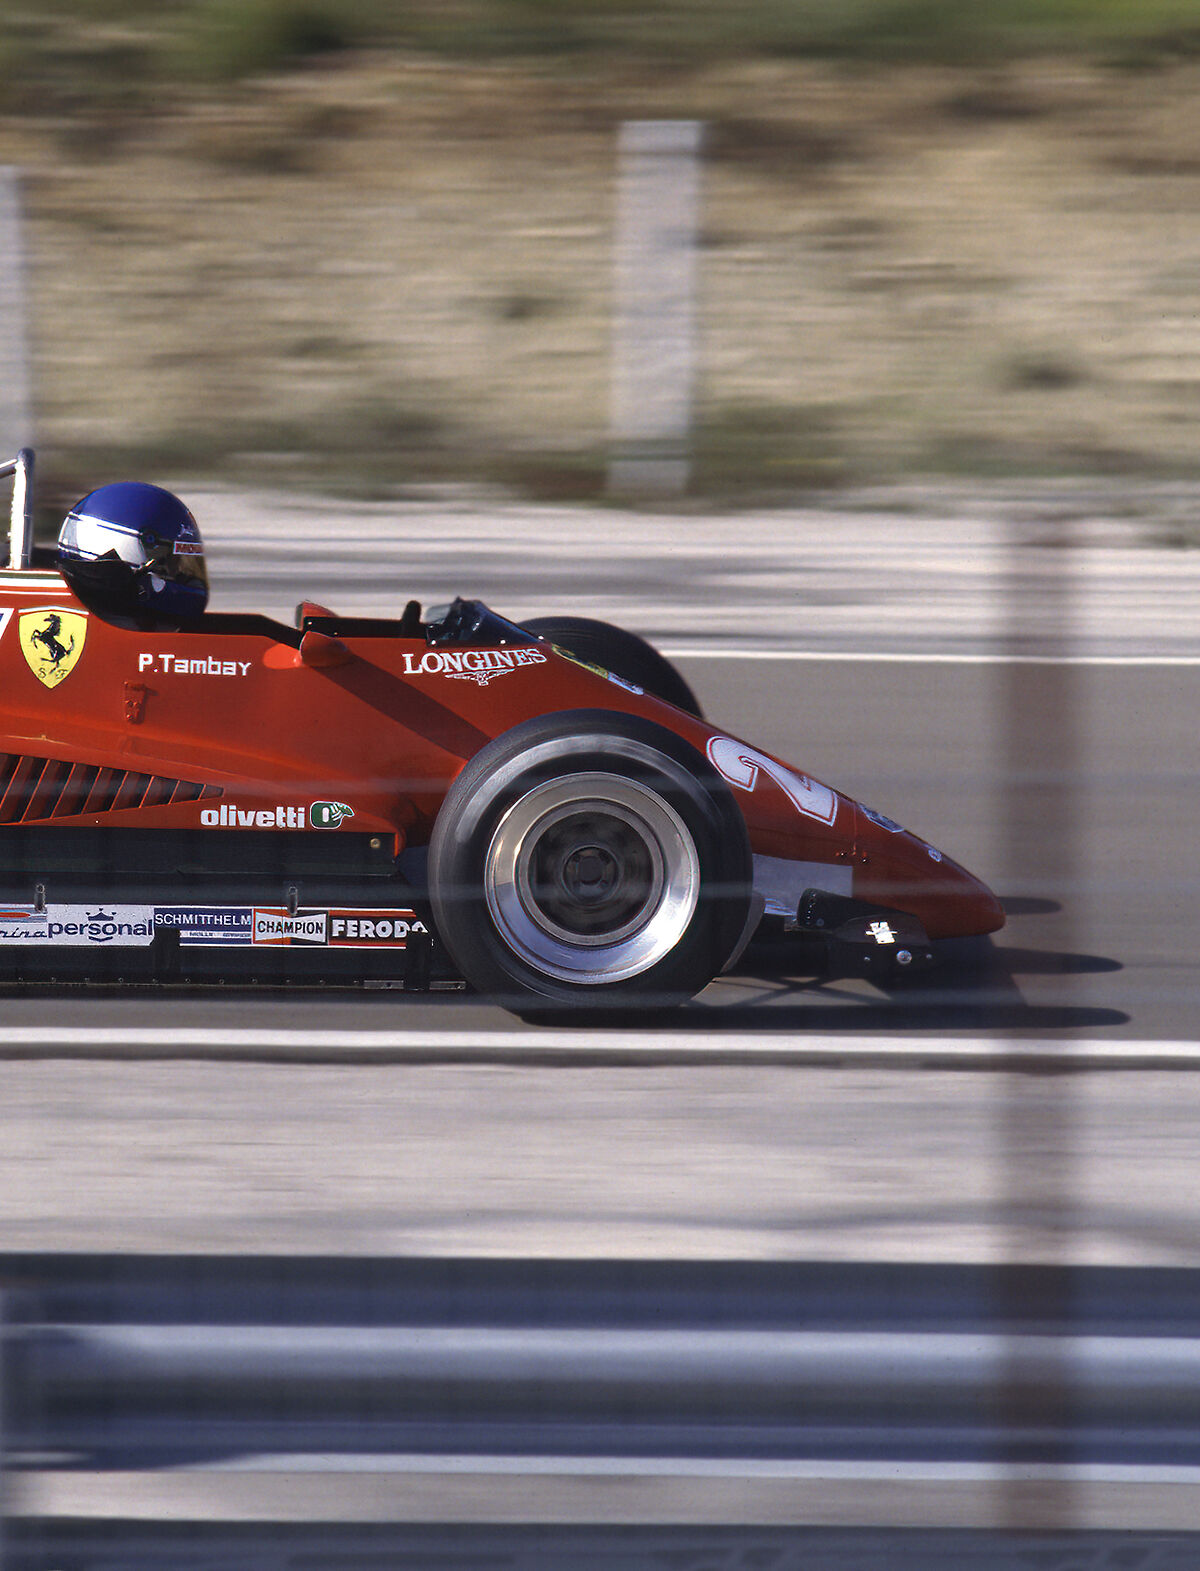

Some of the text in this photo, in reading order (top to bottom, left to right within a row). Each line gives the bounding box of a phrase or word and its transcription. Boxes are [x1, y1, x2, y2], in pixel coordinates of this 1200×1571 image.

[138, 653, 252, 676] P.Tambay
[402, 648, 547, 675] LONGINES
[200, 804, 305, 829] olivetti
[48, 919, 153, 939] personal
[155, 913, 252, 926] SCHMITTHELM
[257, 919, 324, 935] CHAMPION
